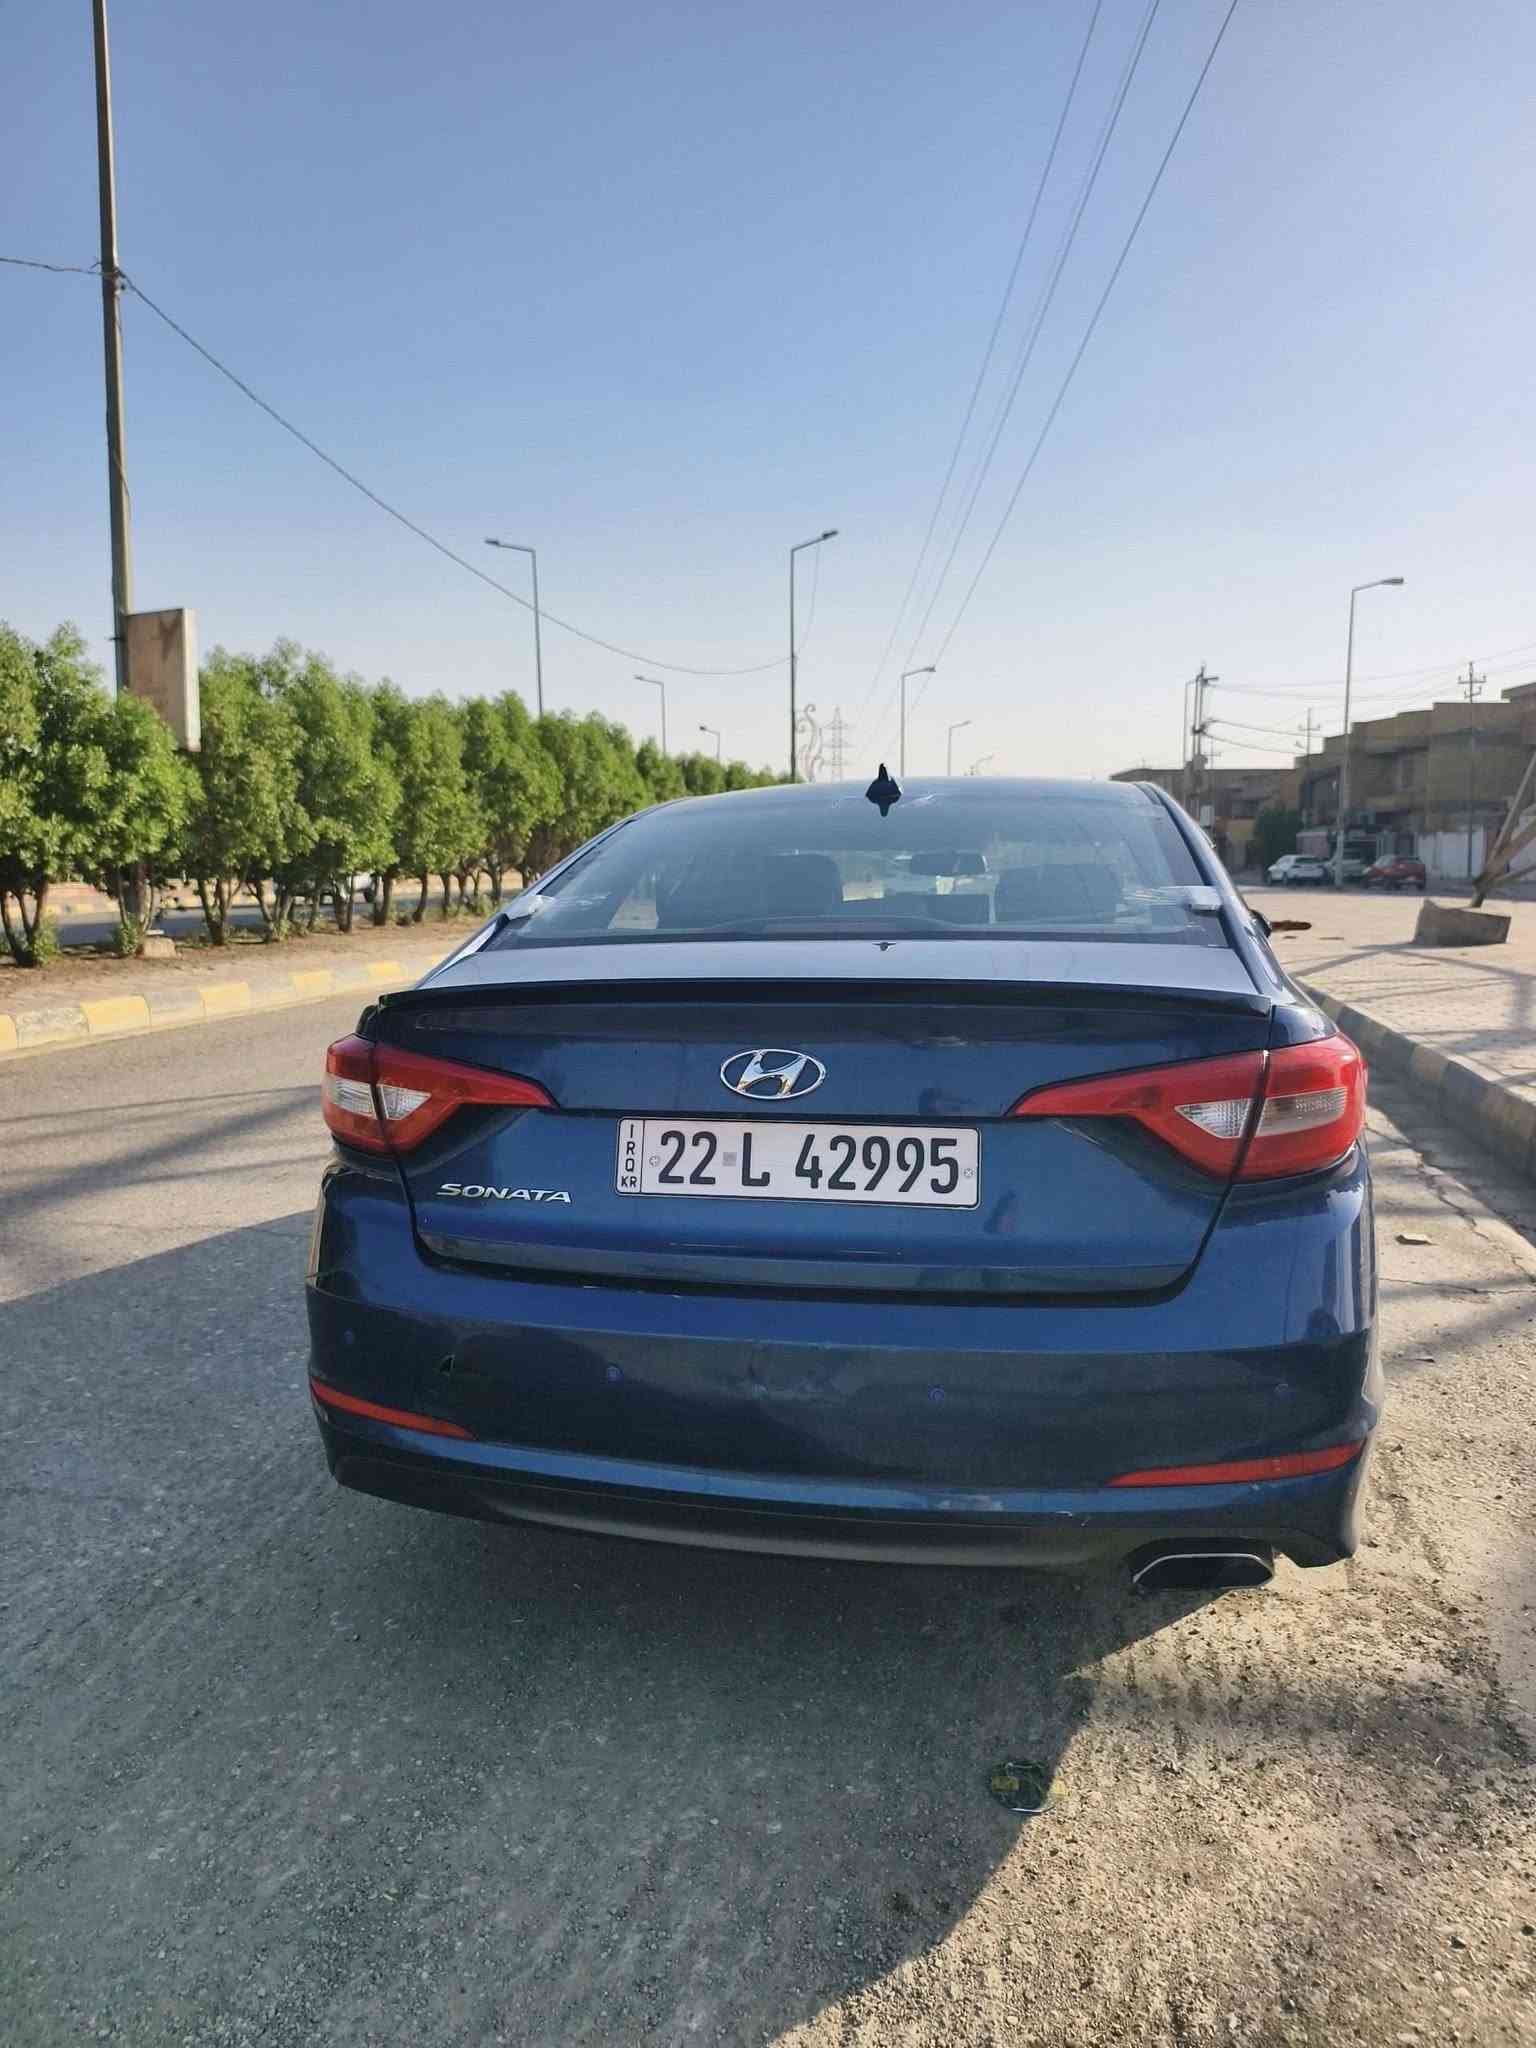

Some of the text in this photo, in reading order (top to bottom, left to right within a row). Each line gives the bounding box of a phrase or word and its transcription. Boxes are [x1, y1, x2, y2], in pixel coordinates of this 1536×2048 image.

[658, 1130, 959, 1194] 22 L 42995
[621, 1176, 637, 1187] KR
[436, 1183, 572, 1203] SONATA
